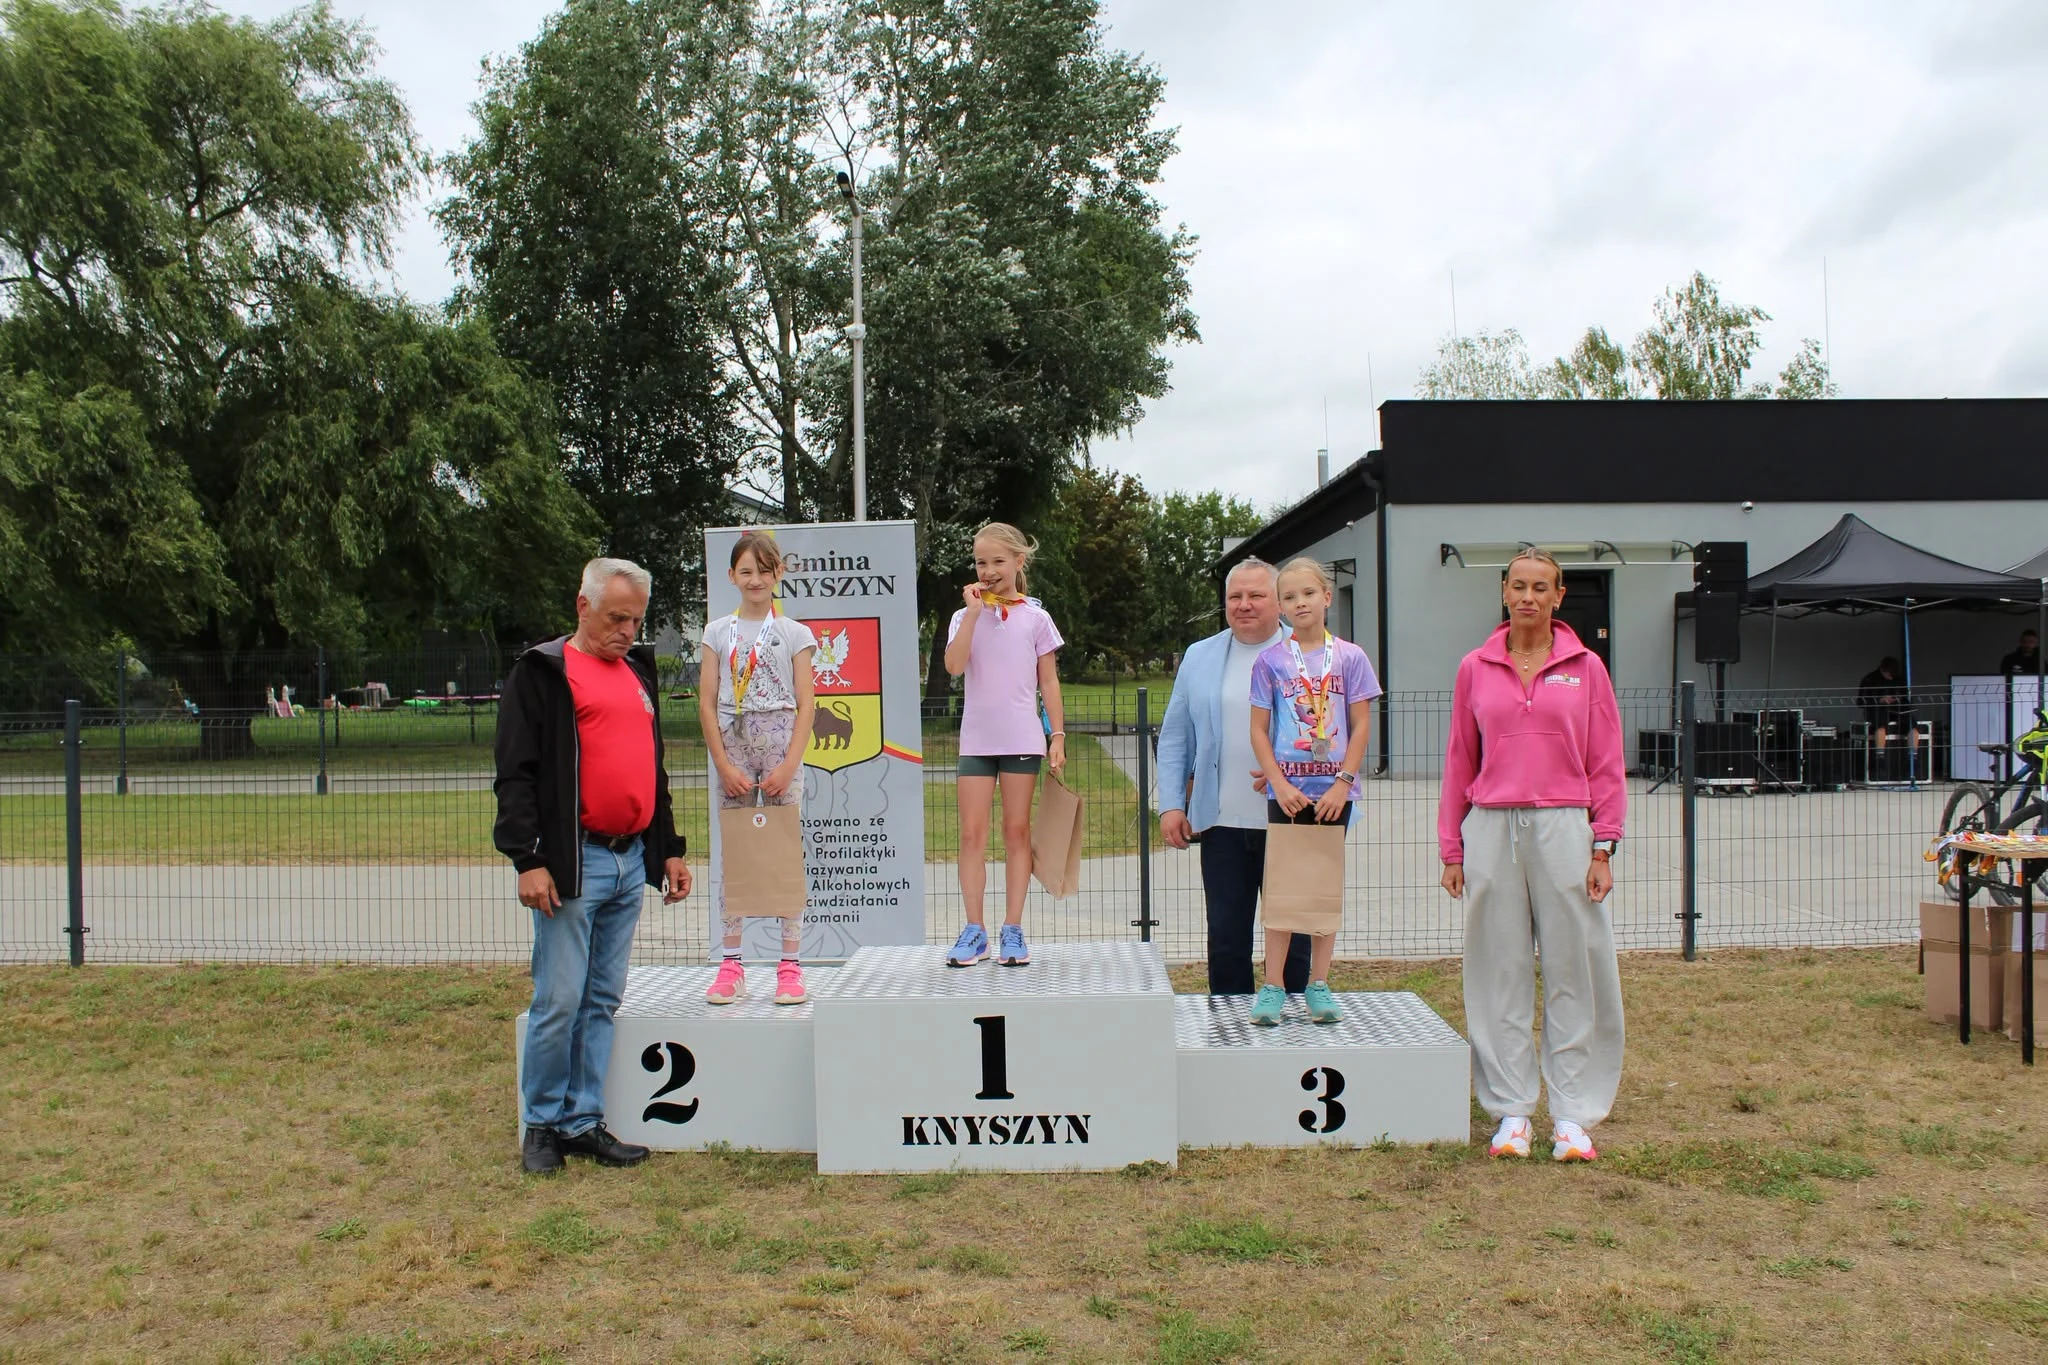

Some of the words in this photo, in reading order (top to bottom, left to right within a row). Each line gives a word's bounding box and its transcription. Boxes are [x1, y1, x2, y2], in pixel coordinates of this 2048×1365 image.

[782, 550, 871, 573] Gmina
[771, 575, 896, 599] NYSZYN
[869, 817, 885, 826] ze
[812, 831, 888, 845] Gminnego
[815, 846, 896, 861] Profilaktyki
[804, 862, 878, 878] iązywania
[811, 878, 910, 893] Alkoholowych
[806, 894, 898, 907] ciwdziałania
[803, 910, 860, 923] komanii
[973, 1016, 1014, 1099] 1
[641, 1042, 698, 1124] 2
[1299, 1067, 1346, 1133] 3
[902, 1115, 1090, 1145] KNYSZYN
